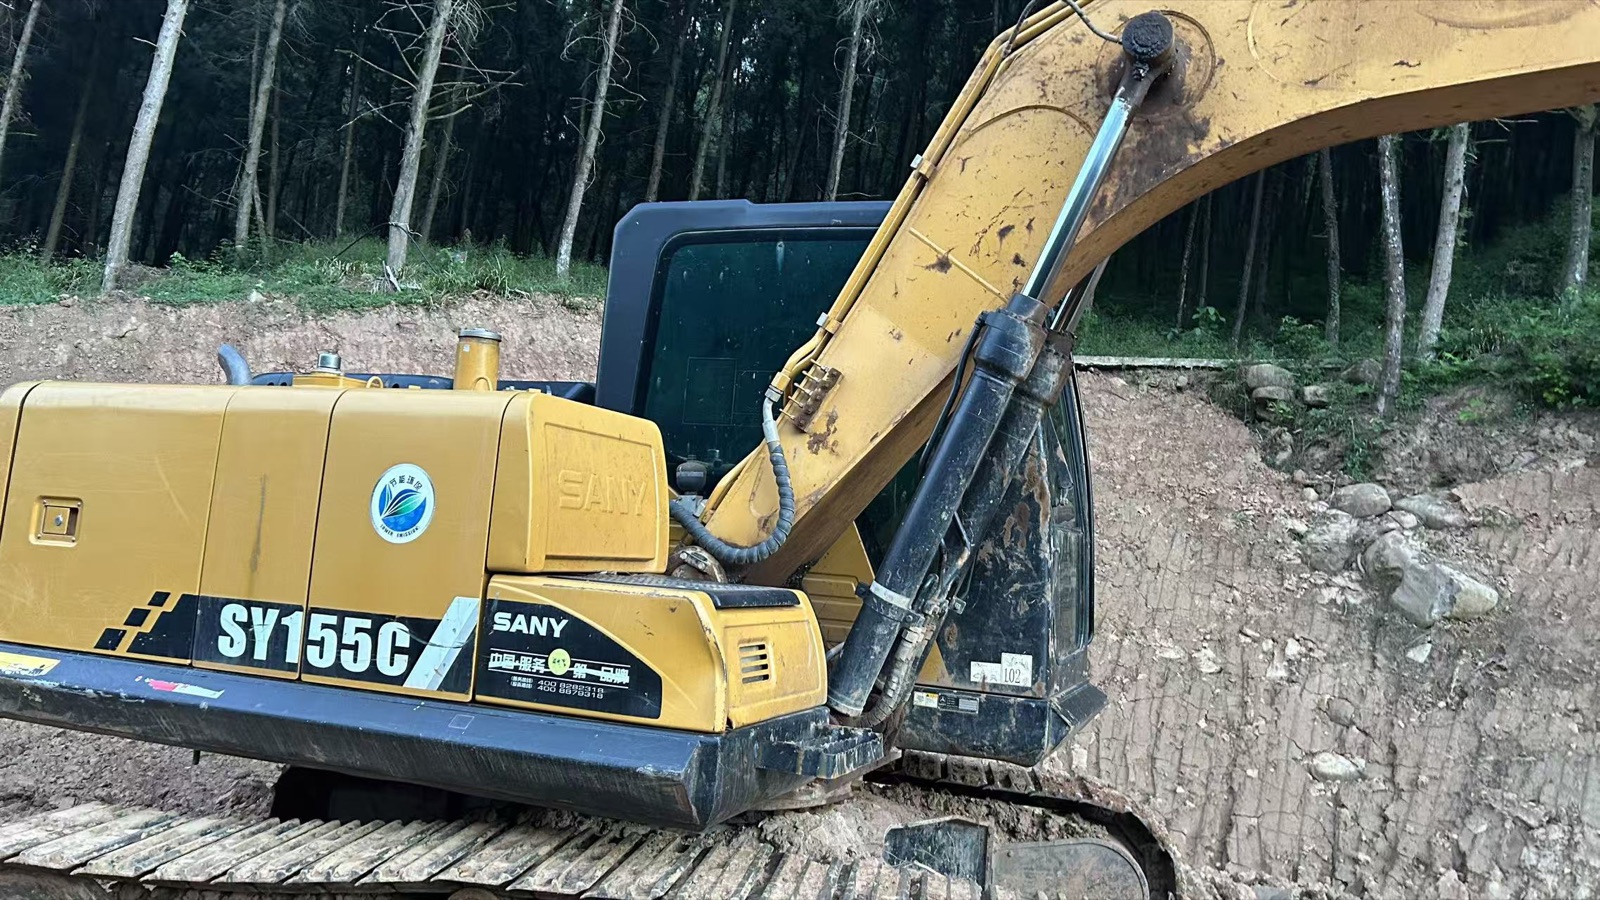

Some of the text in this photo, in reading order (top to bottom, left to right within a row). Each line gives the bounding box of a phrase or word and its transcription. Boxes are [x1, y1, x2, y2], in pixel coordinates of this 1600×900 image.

[558, 469, 647, 516] SANY
[493, 611, 568, 638] SANY
[217, 603, 410, 677] SY155C
[537, 679, 557, 687] 400
[1004, 668, 1021, 684] 102
[537, 685, 556, 693] 400
